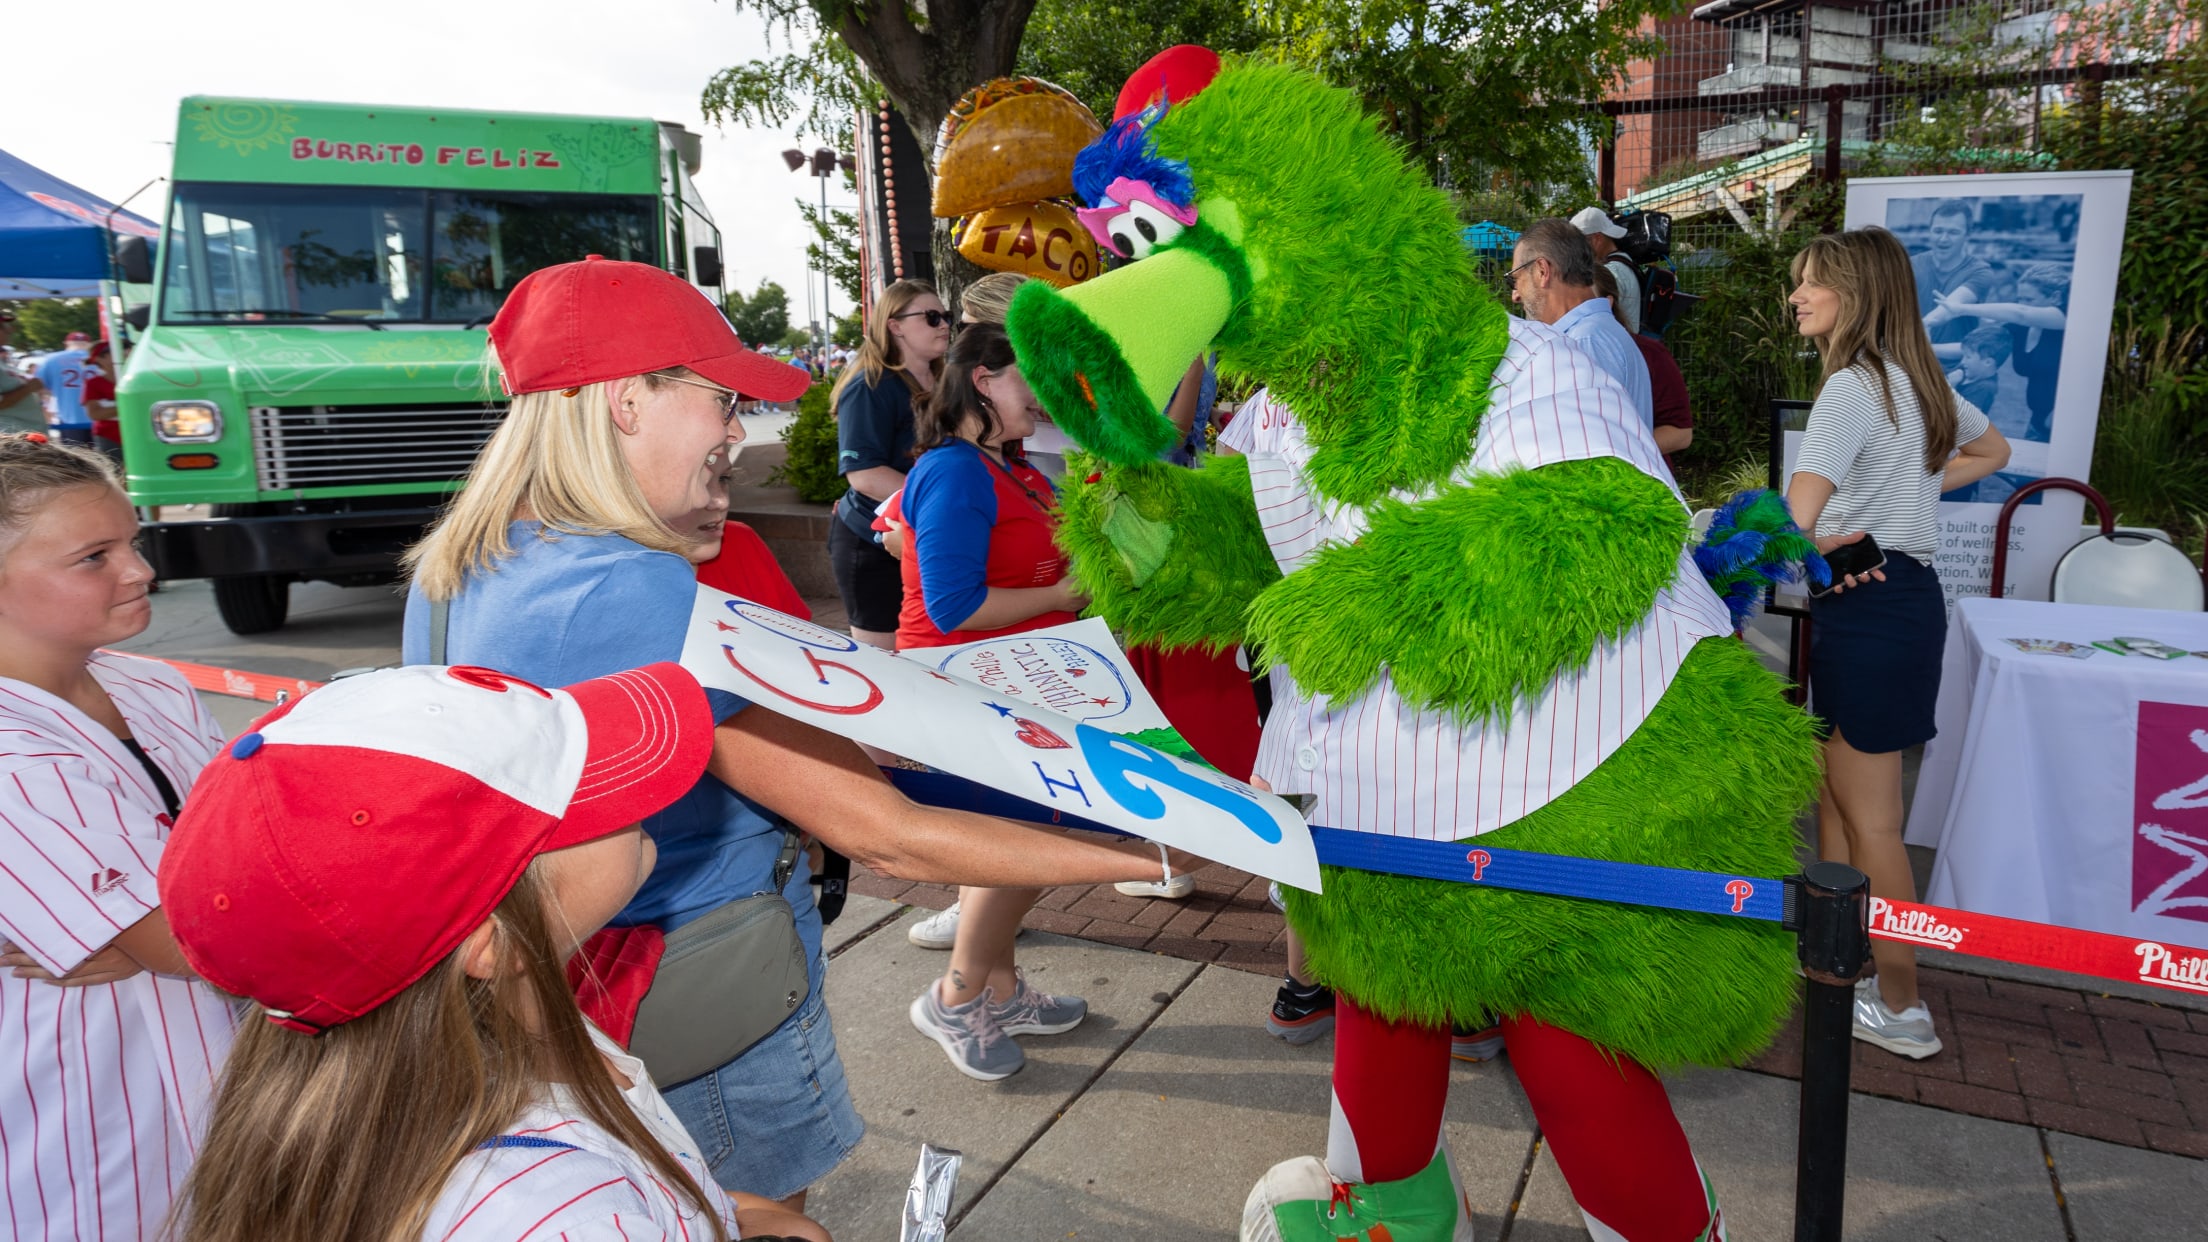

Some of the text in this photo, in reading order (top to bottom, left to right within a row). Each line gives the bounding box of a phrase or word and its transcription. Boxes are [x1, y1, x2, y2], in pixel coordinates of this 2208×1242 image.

[982, 217, 1090, 282] TACO
[1946, 521, 1977, 534] built
[1935, 551, 1979, 566] versity
[1945, 537, 1959, 548] of
[1962, 537, 2024, 552] wellss,
[1937, 566, 1973, 579] ation.
[1956, 584, 1992, 596] powe
[2003, 584, 2016, 595] of
[970, 651, 1007, 687] Phillie
[1046, 642, 1090, 668] HALEY
[1010, 643, 1088, 712] PHANATIC
[1466, 849, 1491, 881] P
[1725, 879, 1753, 913] P
[1868, 896, 1963, 944] Phillies
[2134, 942, 2208, 986] Phill
